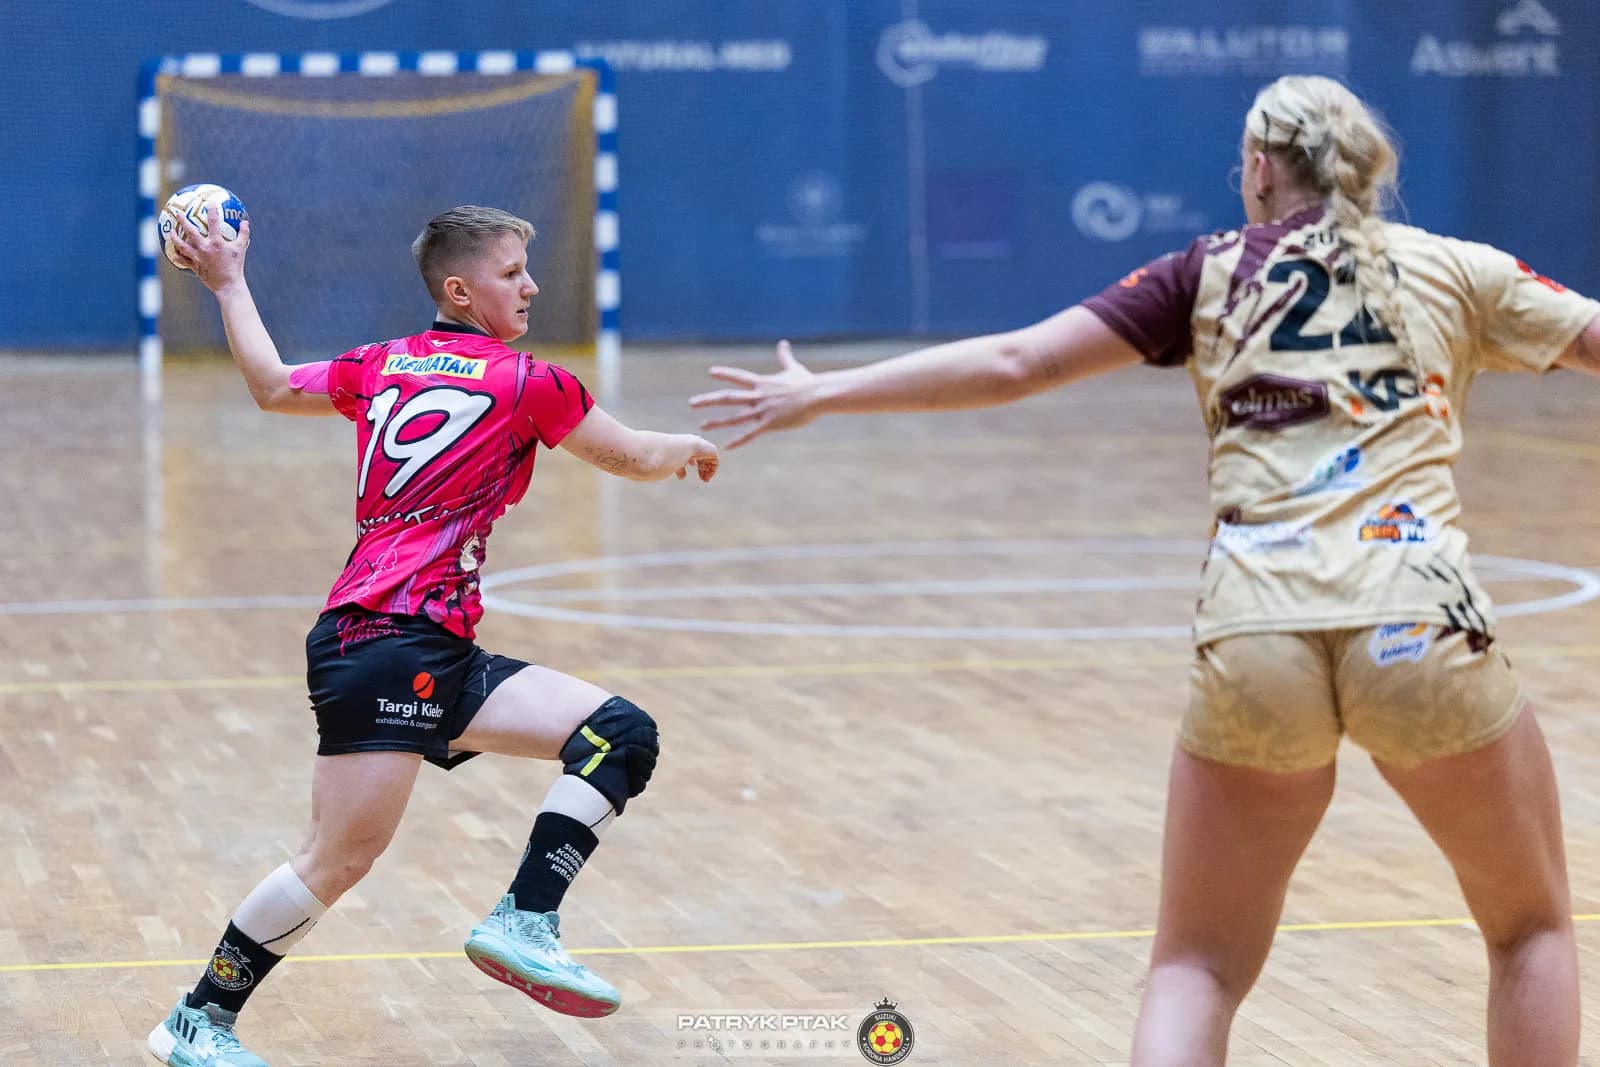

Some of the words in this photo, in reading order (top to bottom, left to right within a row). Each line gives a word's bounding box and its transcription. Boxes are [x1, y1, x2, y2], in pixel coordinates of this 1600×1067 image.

[357, 384, 495, 499] 19
[377, 698, 418, 718] Targi
[375, 717, 409, 726] exhibition
[220, 950, 243, 969] SUZUKI
